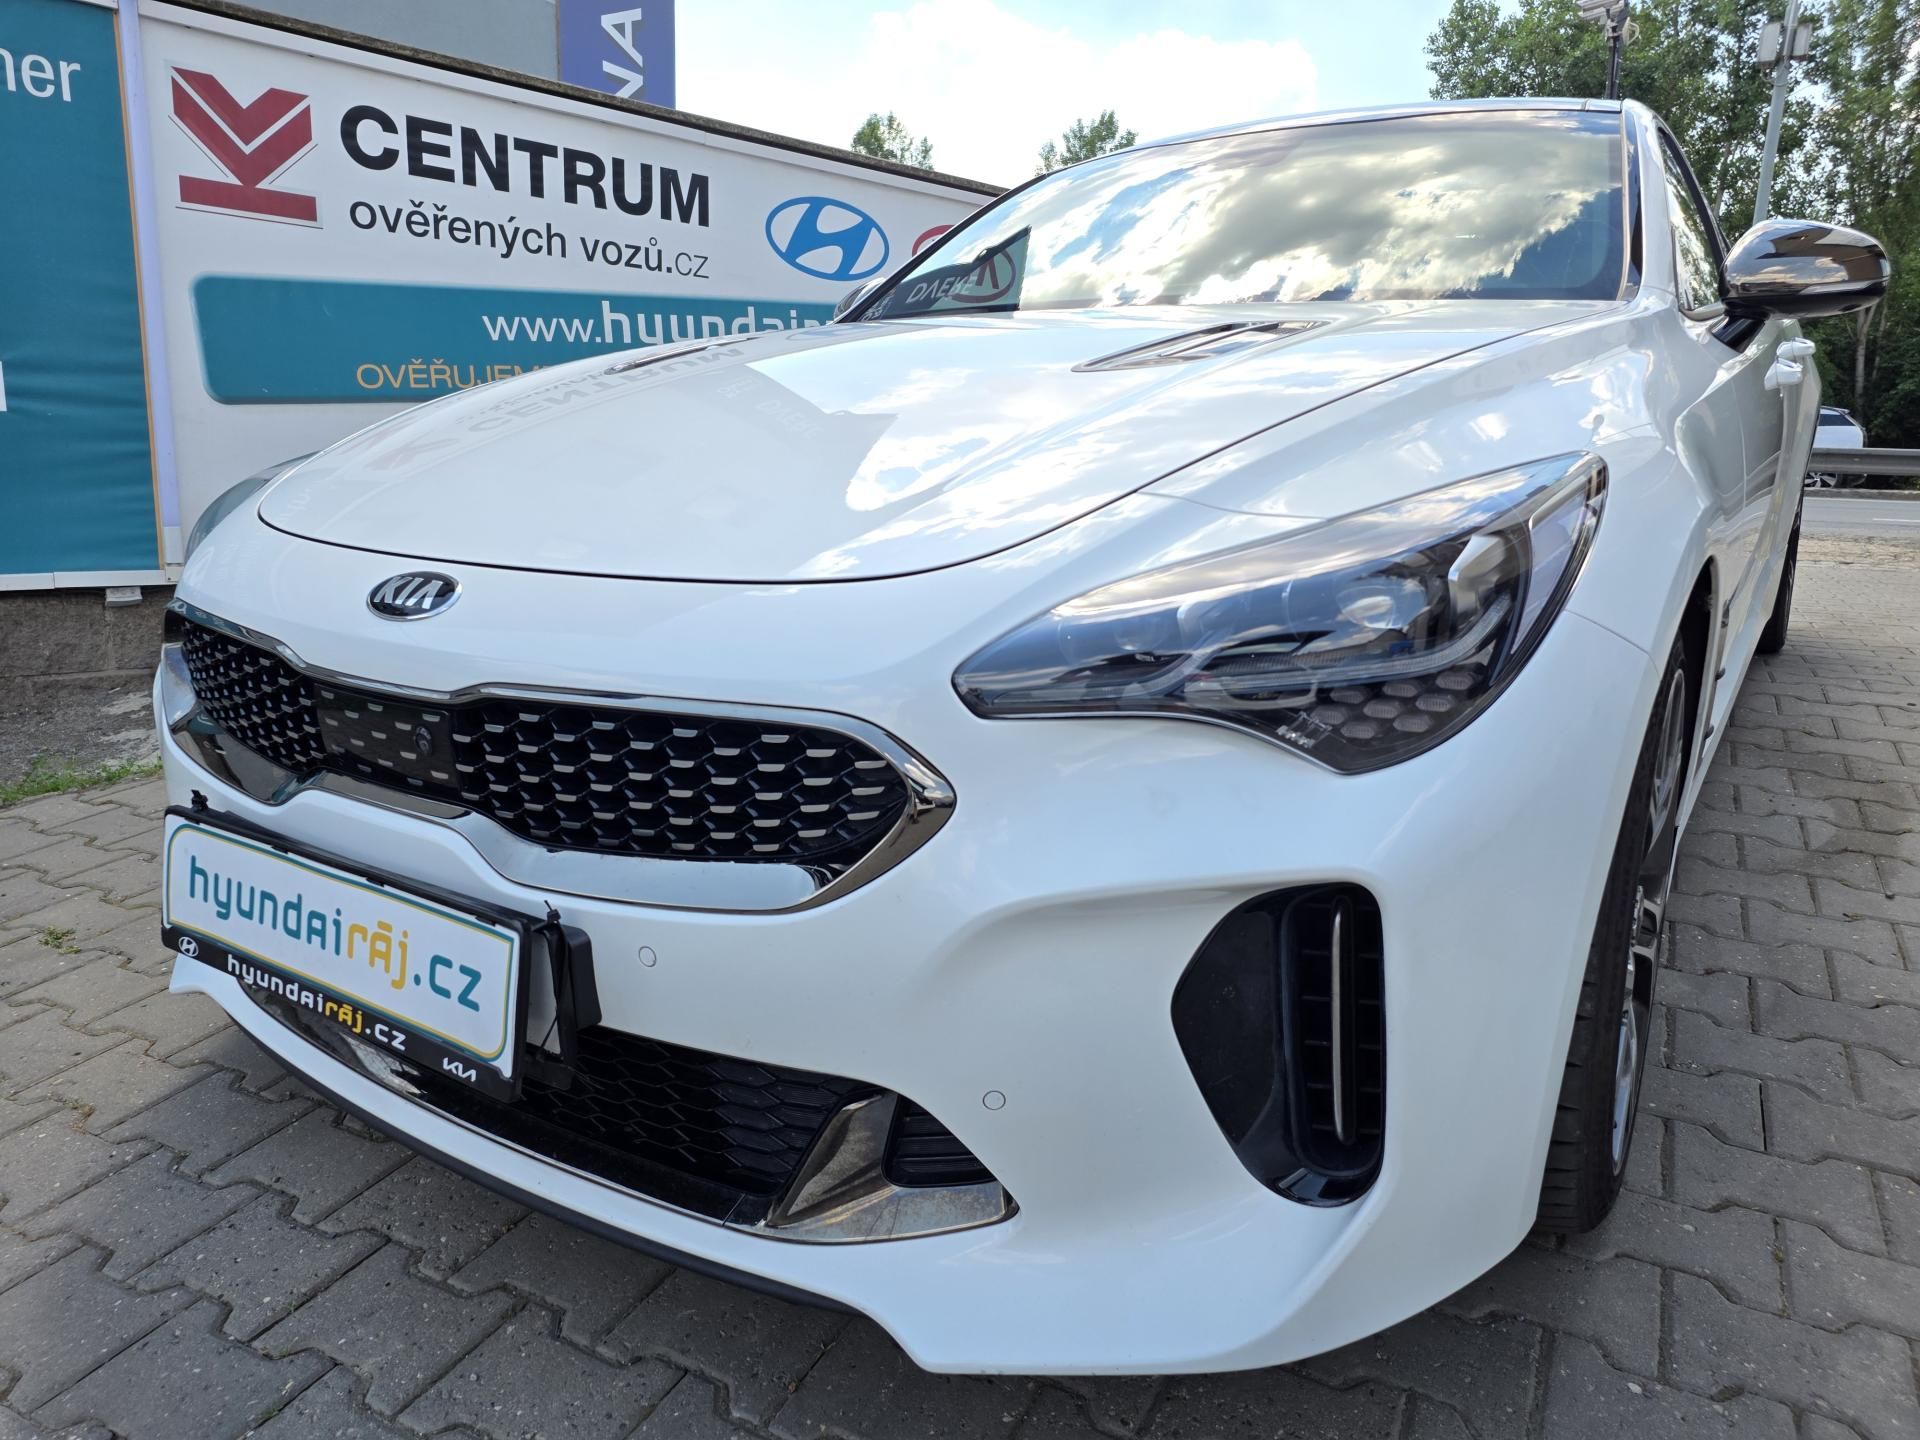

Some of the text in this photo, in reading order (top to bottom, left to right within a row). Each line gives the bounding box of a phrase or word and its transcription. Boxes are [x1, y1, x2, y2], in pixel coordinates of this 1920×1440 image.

[340, 104, 710, 228] CENTRUM
[349, 199, 710, 279] ověřených vozů.cz
[373, 576, 443, 610] KIA
